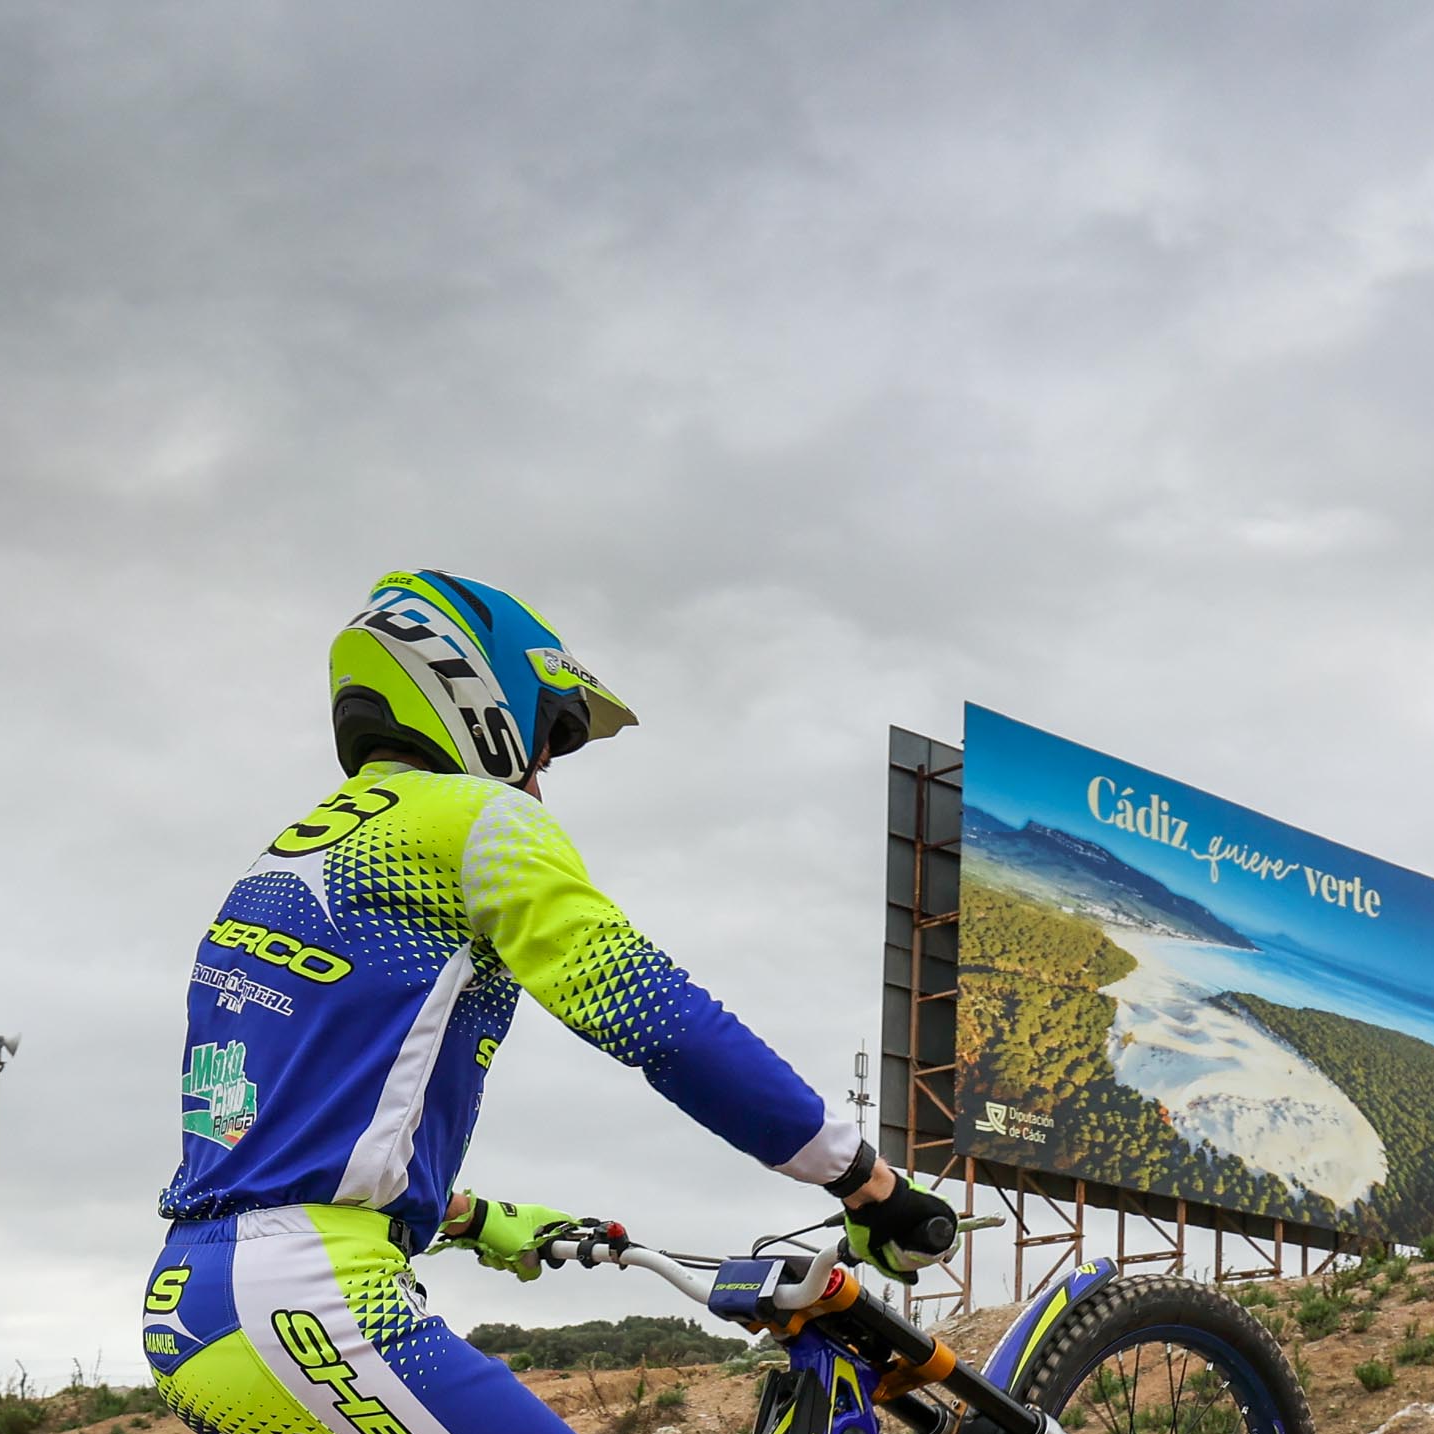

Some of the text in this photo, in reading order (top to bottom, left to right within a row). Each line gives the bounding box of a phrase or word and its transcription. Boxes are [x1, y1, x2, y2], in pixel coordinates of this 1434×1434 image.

[387, 577, 414, 586] RACE
[561, 660, 599, 688] RACE
[1087, 775, 1382, 918] Cádiz quiere verte
[209, 919, 353, 983] HERCO
[191, 1040, 247, 1092] Moto
[210, 1081, 247, 1118] Club
[212, 1109, 255, 1137] Ronda
[1009, 1107, 1054, 1128] Diputación
[1009, 1125, 1046, 1144] de Cádiz
[144, 1264, 192, 1314] S
[145, 1332, 179, 1355] MANUEL
